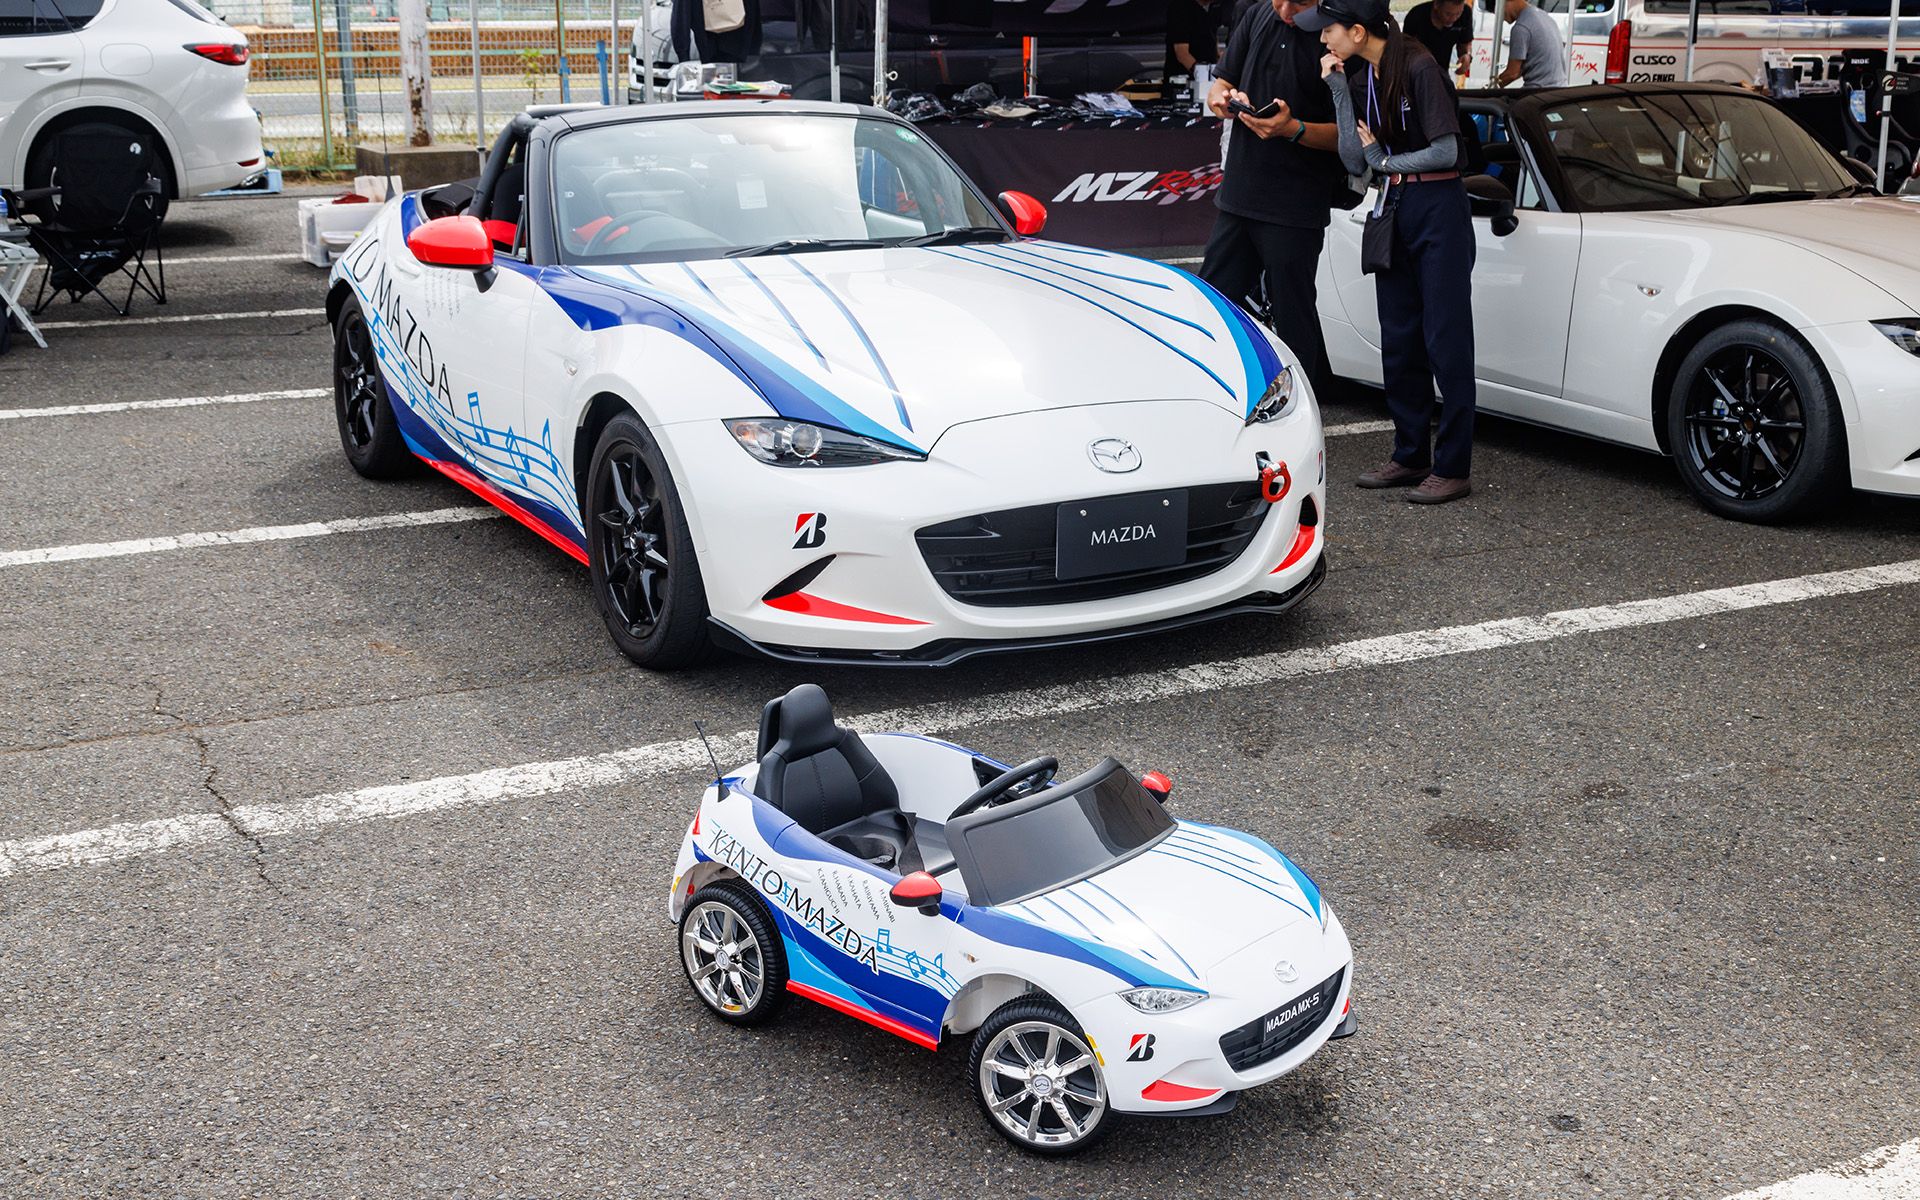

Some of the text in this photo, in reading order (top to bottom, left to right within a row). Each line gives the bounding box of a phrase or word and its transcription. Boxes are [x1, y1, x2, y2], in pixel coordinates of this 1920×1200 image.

[1633, 55, 1676, 65] CUSCO
[371, 262, 456, 419] MAZDA
[1090, 524, 1156, 546] MAZDA
[708, 829, 878, 974] KANTO MAZDA
[817, 867, 841, 914] K.TANIGUCHI
[832, 870, 849, 907] R.HARADA
[862, 880, 881, 920] R.KIRIYAMA
[879, 888, 896, 923] H.MINARI
[1266, 991, 1320, 1033] MAZDA MX-5
